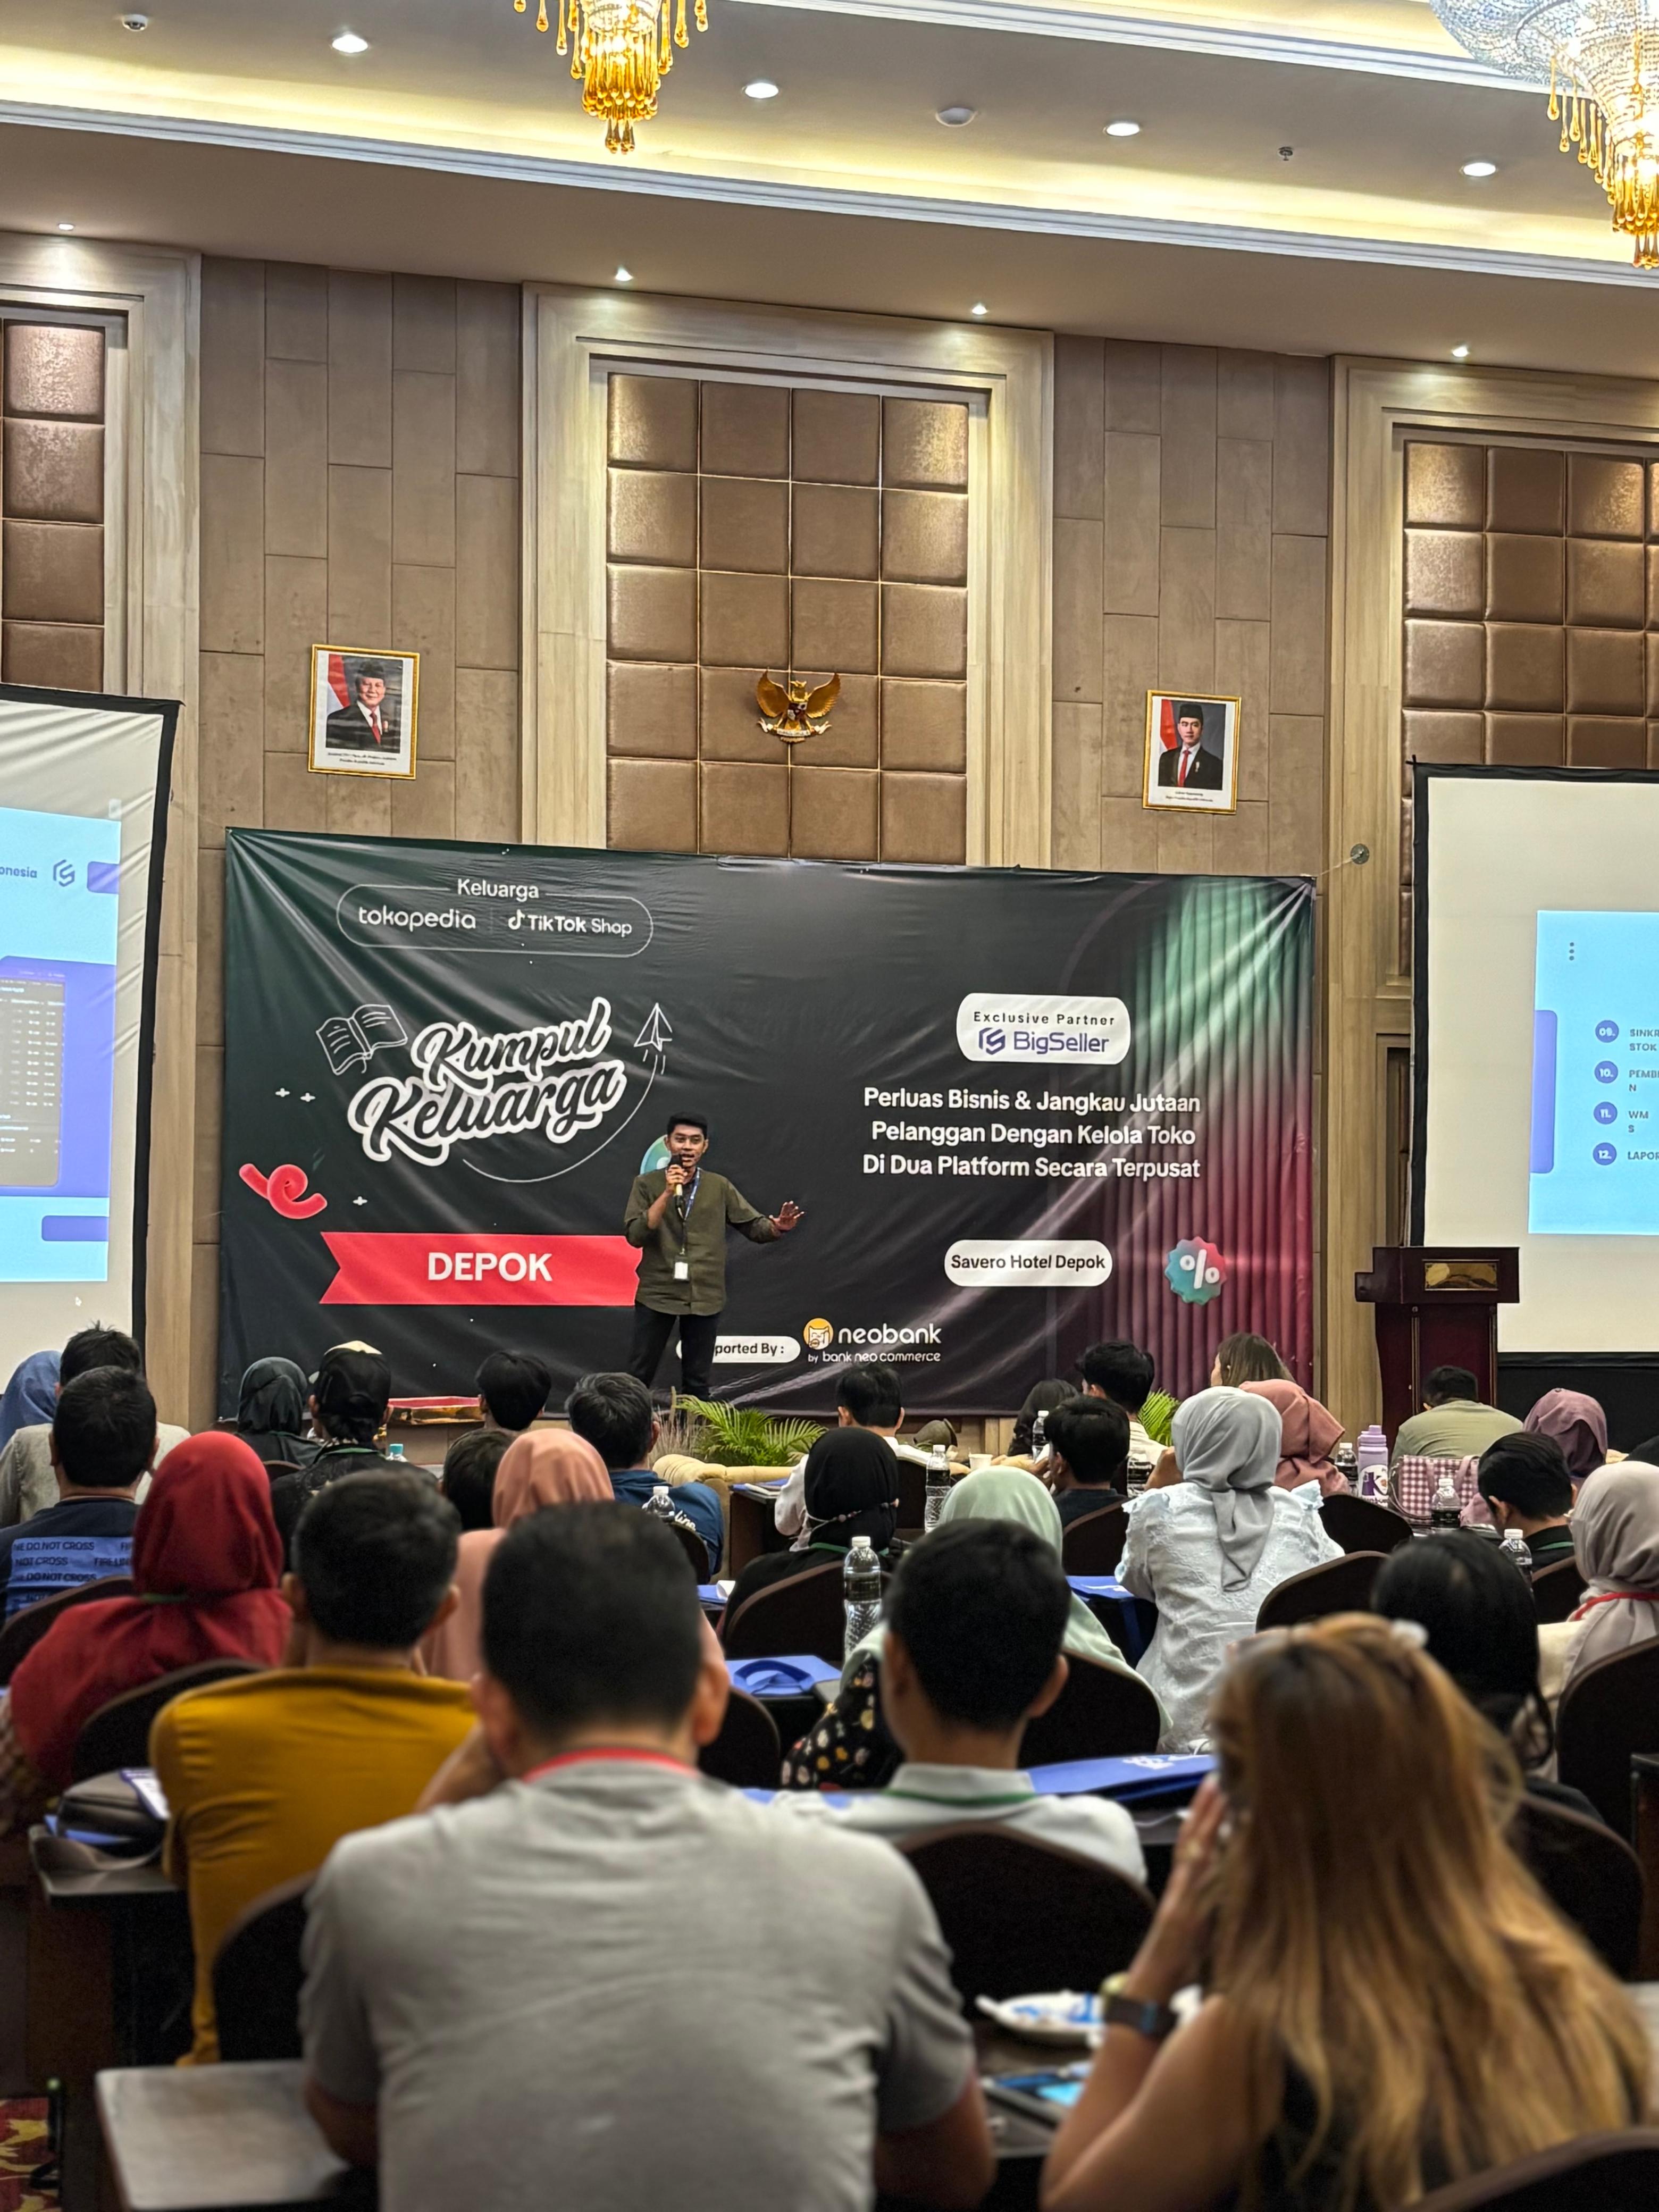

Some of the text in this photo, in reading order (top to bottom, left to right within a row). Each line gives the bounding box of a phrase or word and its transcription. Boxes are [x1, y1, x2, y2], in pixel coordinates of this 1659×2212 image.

[458, 879, 539, 902] Keluarga
[358, 906, 476, 932] tokopedia
[528, 914, 632, 937] TikTok Shop
[974, 1011, 1115, 1026] Exclusive Partner
[410, 997, 612, 1095] Kumpul
[1013, 1031, 1110, 1054] BigSeller
[1629, 1042, 1657, 1051] STOK
[1599, 1068, 1613, 1078] 10.
[864, 1087, 1201, 1116] Perluas Bisnis & Jangkau Jutaan
[347, 1060, 627, 1167] Keluarga
[1628, 1110, 1649, 1119] WM
[872, 1121, 1196, 1148] Pelanggan Dengan Kelola Toko
[1598, 1150, 1612, 1159] 12.
[863, 1154, 1201, 1182] Di Dua Platform Secara Terpusat
[428, 1252, 553, 1282] DEPOK
[951, 1254, 1105, 1272] Savero Hotel Depok
[838, 1323, 942, 1345] neobank
[715, 1343, 758, 1356] ported
[761, 1343, 776, 1356] By
[808, 1351, 941, 1364] by bank neo commerce
[27, 1542, 40, 1551] DO
[41, 1541, 60, 1551] NOT
[62, 1541, 95, 1551] CROSS
